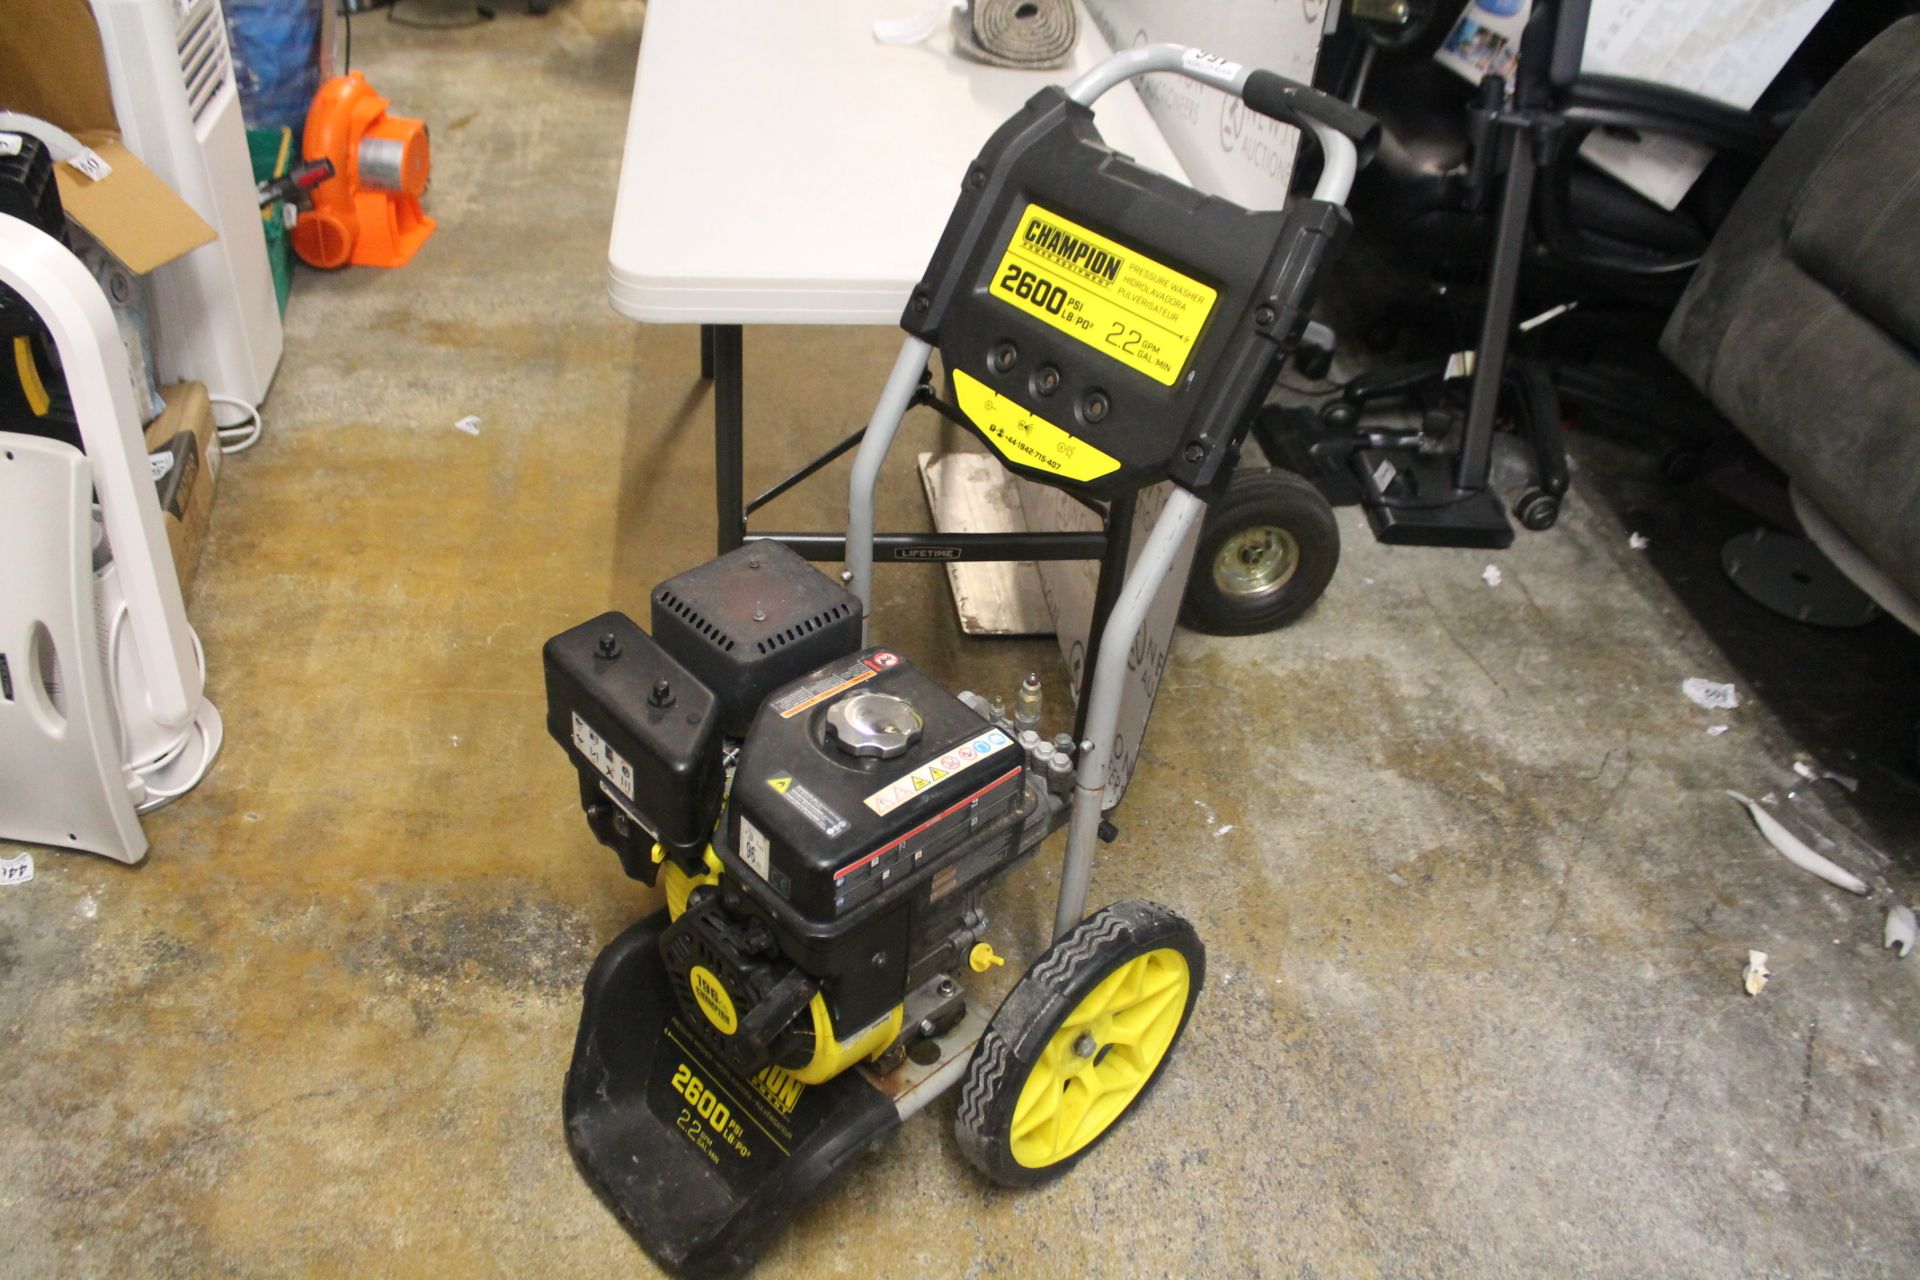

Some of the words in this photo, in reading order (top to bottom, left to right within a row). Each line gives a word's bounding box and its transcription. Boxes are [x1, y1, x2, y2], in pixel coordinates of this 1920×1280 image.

[1025, 219, 1121, 281] CHAMPION
[1000, 264, 1067, 316] 2600
[1067, 297, 1084, 312] PSI
[1123, 275, 1186, 311] HIDROLAVADORA
[1129, 263, 1169, 288] PRESSURE
[1170, 282, 1205, 304] WASHER
[1105, 321, 1142, 355] 2.2
[1141, 339, 1161, 355] GPM
[1137, 350, 1172, 372] GAL/MIN
[902, 549, 954, 557] LIFETIME
[671, 1063, 730, 1133] 2600
[728, 1119, 744, 1138] PSI
[676, 1108, 702, 1142] 2.2
